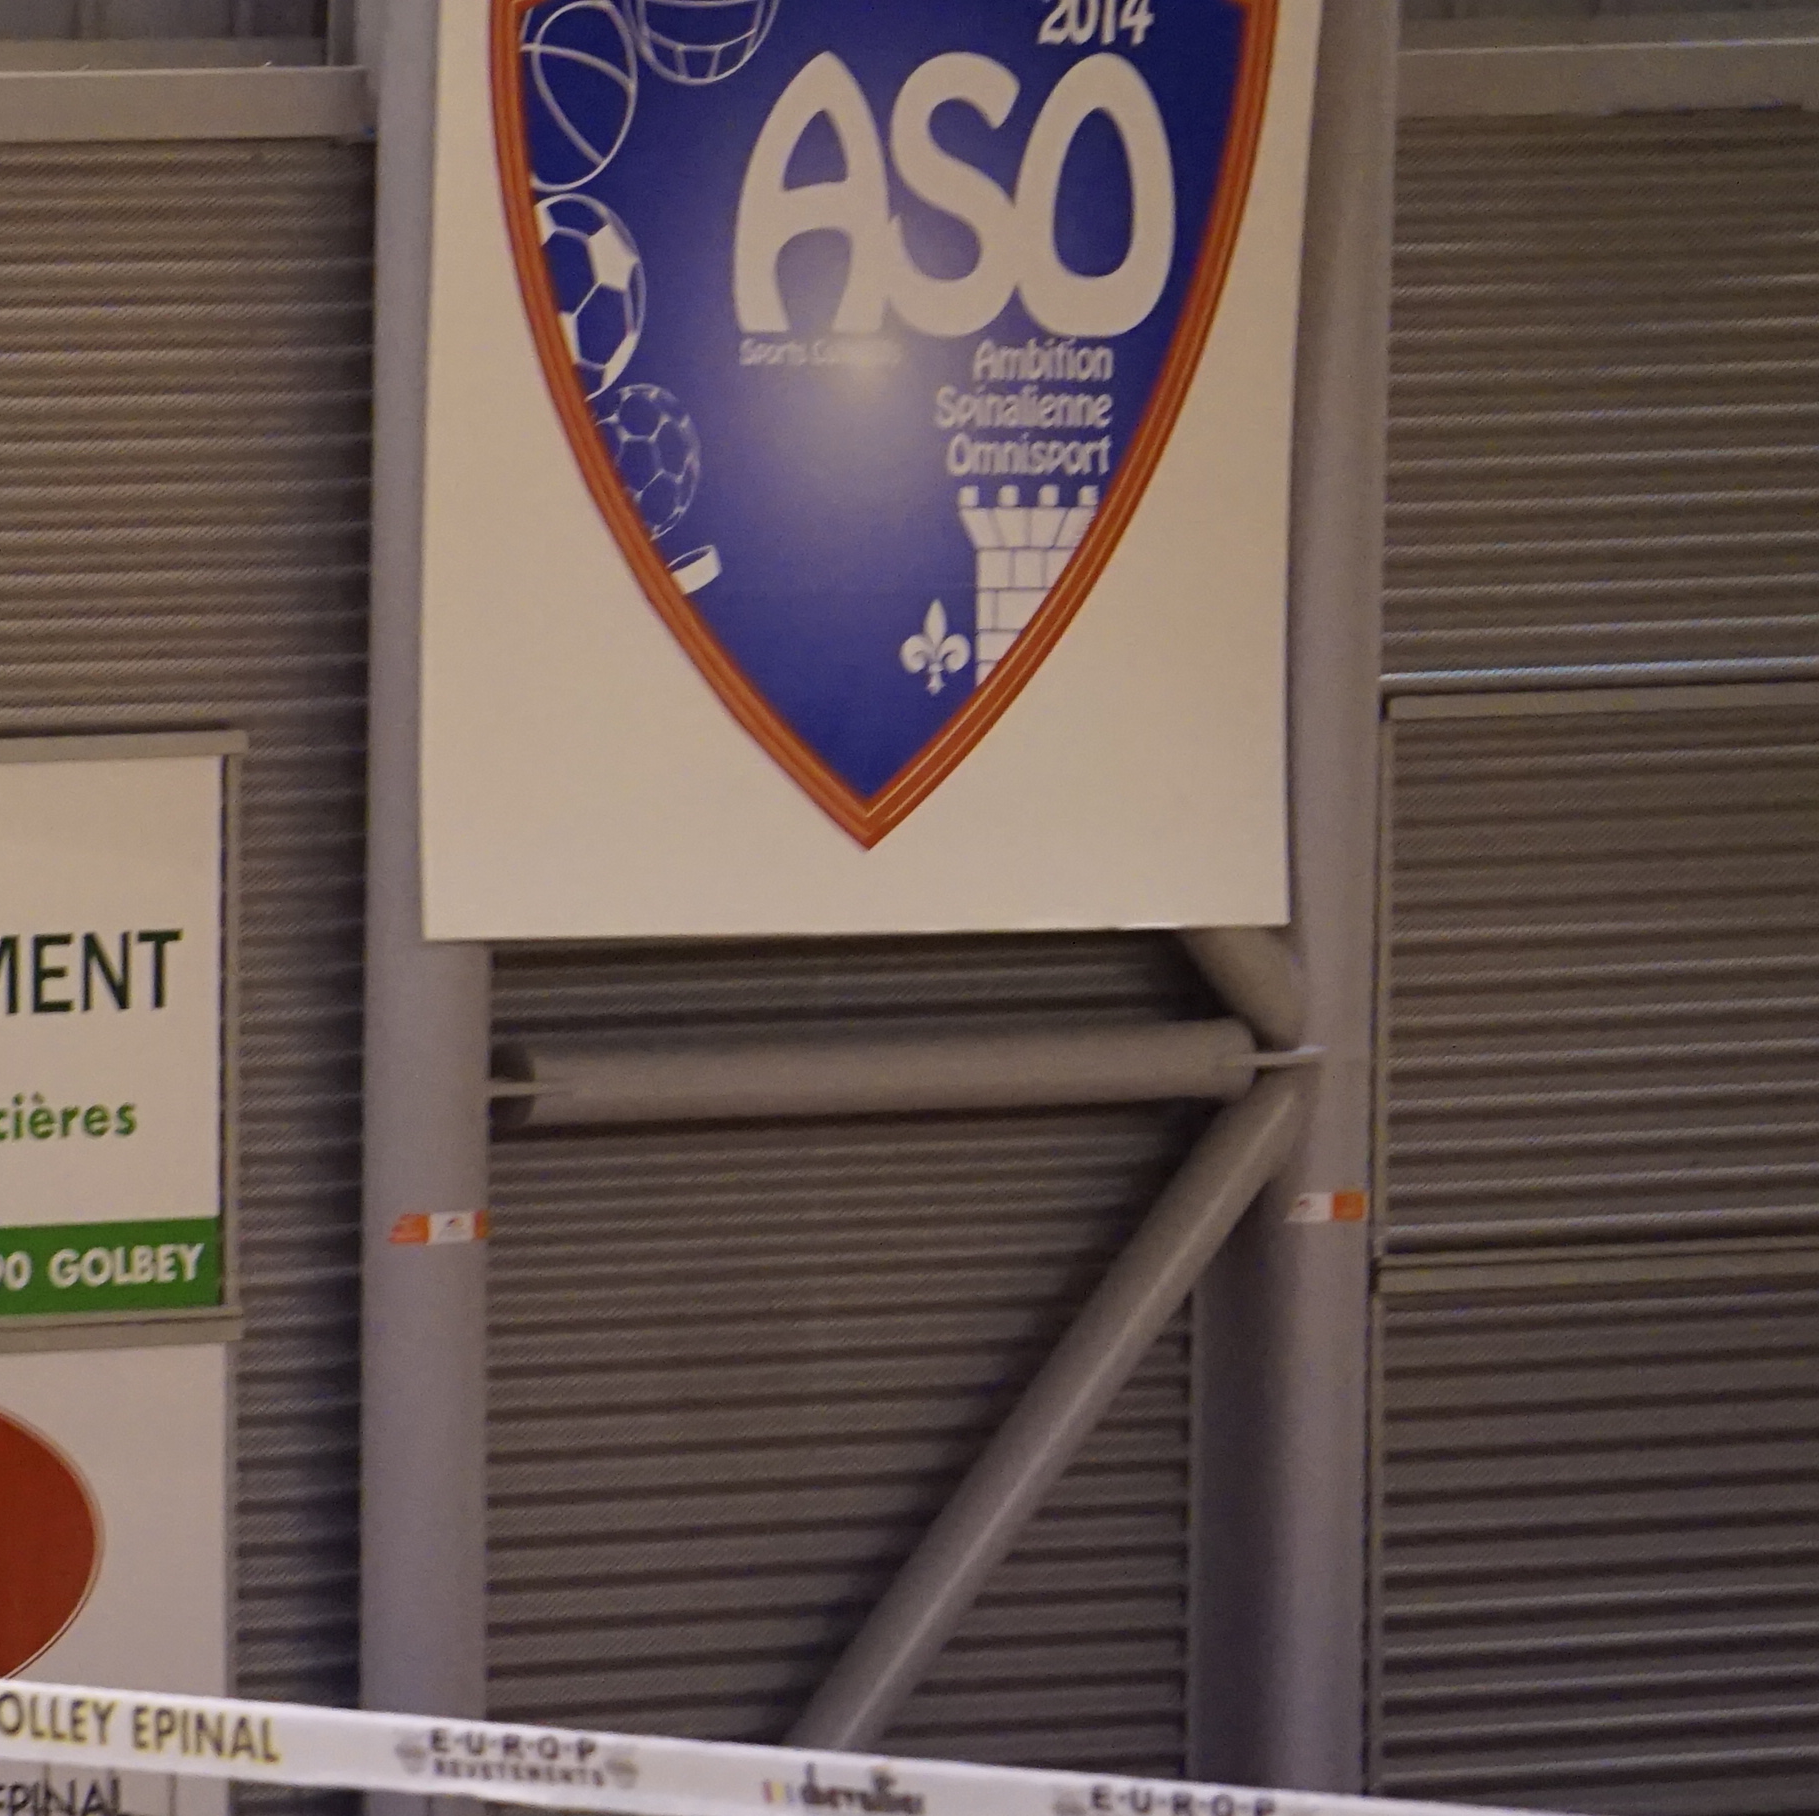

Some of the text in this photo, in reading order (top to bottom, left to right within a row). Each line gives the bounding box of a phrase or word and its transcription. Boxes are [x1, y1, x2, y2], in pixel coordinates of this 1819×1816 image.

[733, 51, 1176, 338] ASO
[973, 339, 1113, 380] Ambition
[936, 384, 1113, 428] Spinalienne
[947, 432, 1111, 477] Omnisport
[48, 1242, 206, 1292] GOLBEY
[131, 1703, 281, 1764] EPINAL
